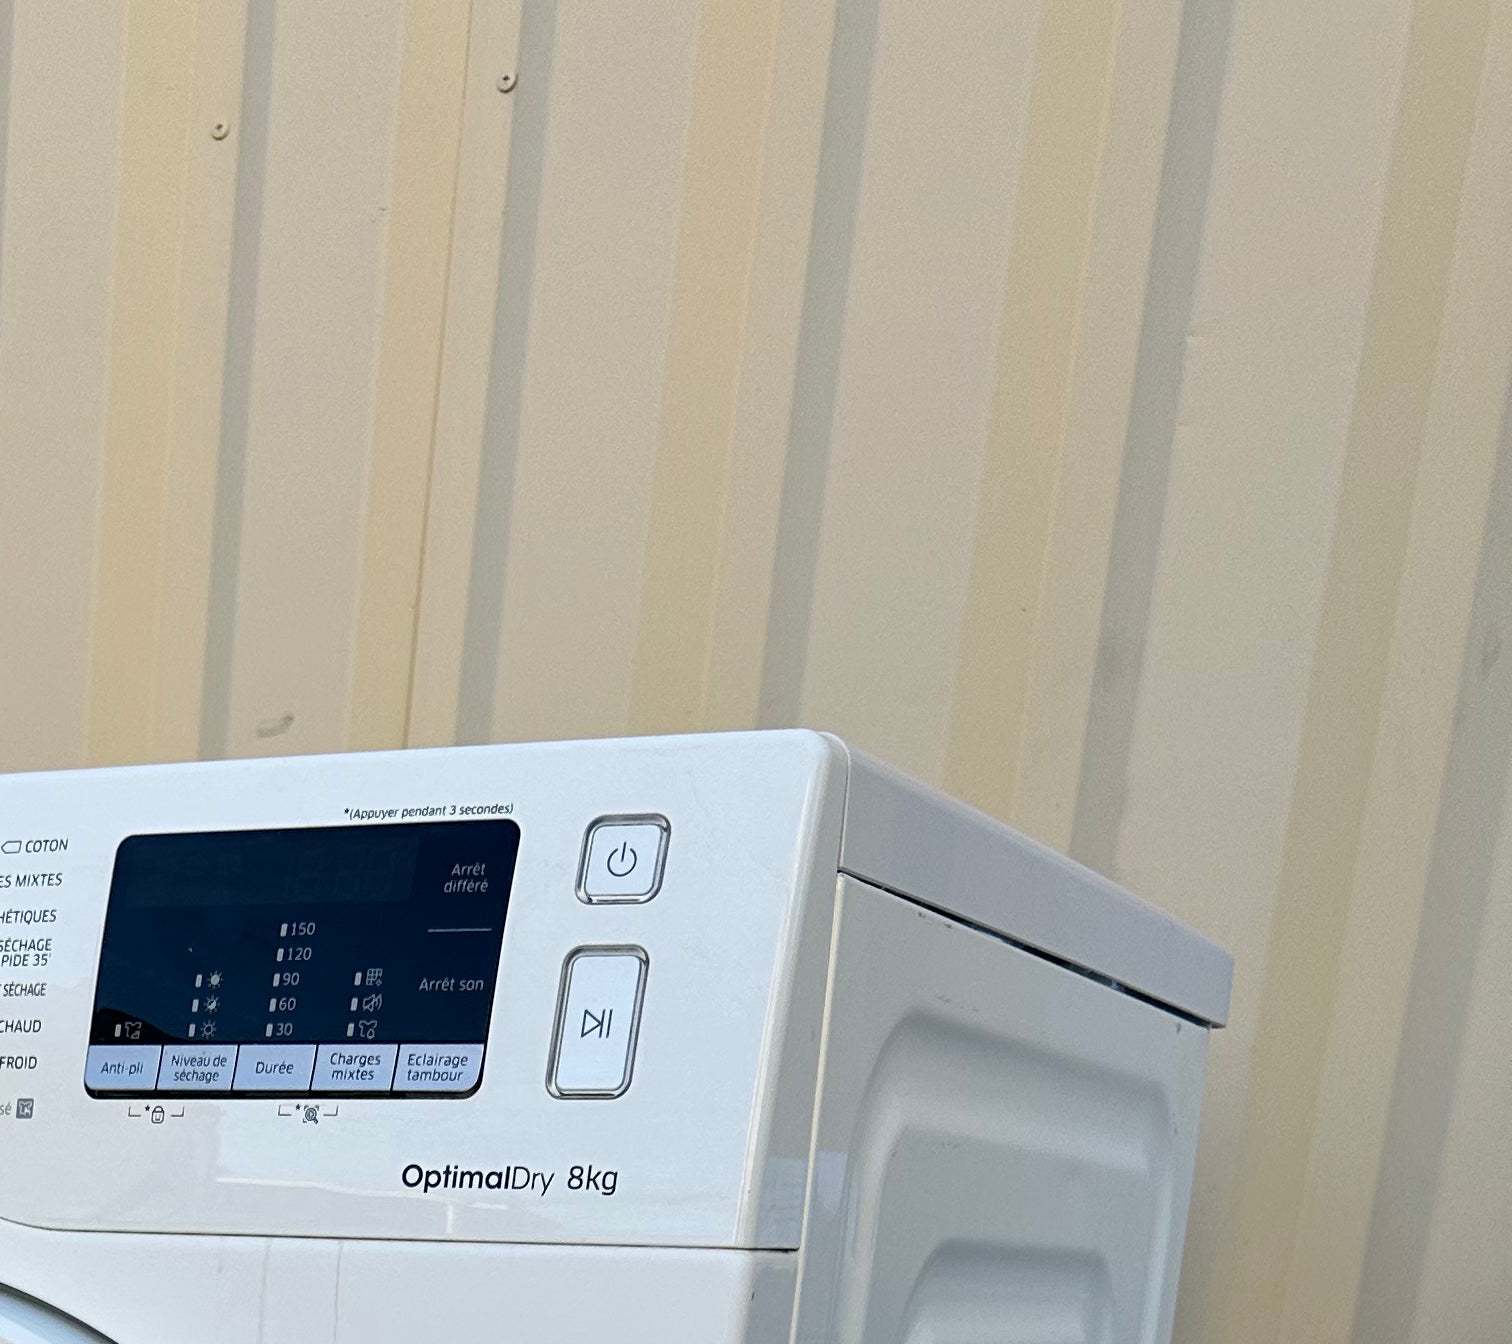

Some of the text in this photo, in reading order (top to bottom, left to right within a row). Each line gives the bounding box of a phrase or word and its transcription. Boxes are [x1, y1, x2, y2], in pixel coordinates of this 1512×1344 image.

[401, 805, 446, 819] pendant
[449, 805, 456, 815] 3
[459, 803, 514, 815] secondes)
[25, 838, 68, 853] COTON
[451, 862, 485, 876] Arrêt
[15, 873, 63, 887] MIXTES
[444, 879, 489, 893] différé
[291, 922, 316, 936] 150
[287, 948, 312, 961] 120
[282, 973, 300, 986] 90
[419, 977, 484, 991] Arrêt son
[3, 981, 47, 997] SÉCHAGE
[278, 998, 296, 1011] 60
[275, 1023, 293, 1037] 30
[0, 1056, 37, 1069] FROID
[171, 1054, 228, 1068] Niveau de
[330, 1052, 381, 1068] Charges
[408, 1053, 469, 1069] Eclairage
[101, 1061, 144, 1076] Anti-pli
[255, 1061, 294, 1075] Durée
[331, 1068, 375, 1081] mixtes
[407, 1069, 464, 1081] tambour
[173, 1069, 220, 1083] séchage
[401, 1164, 618, 1196] OptimalDry 8kg
